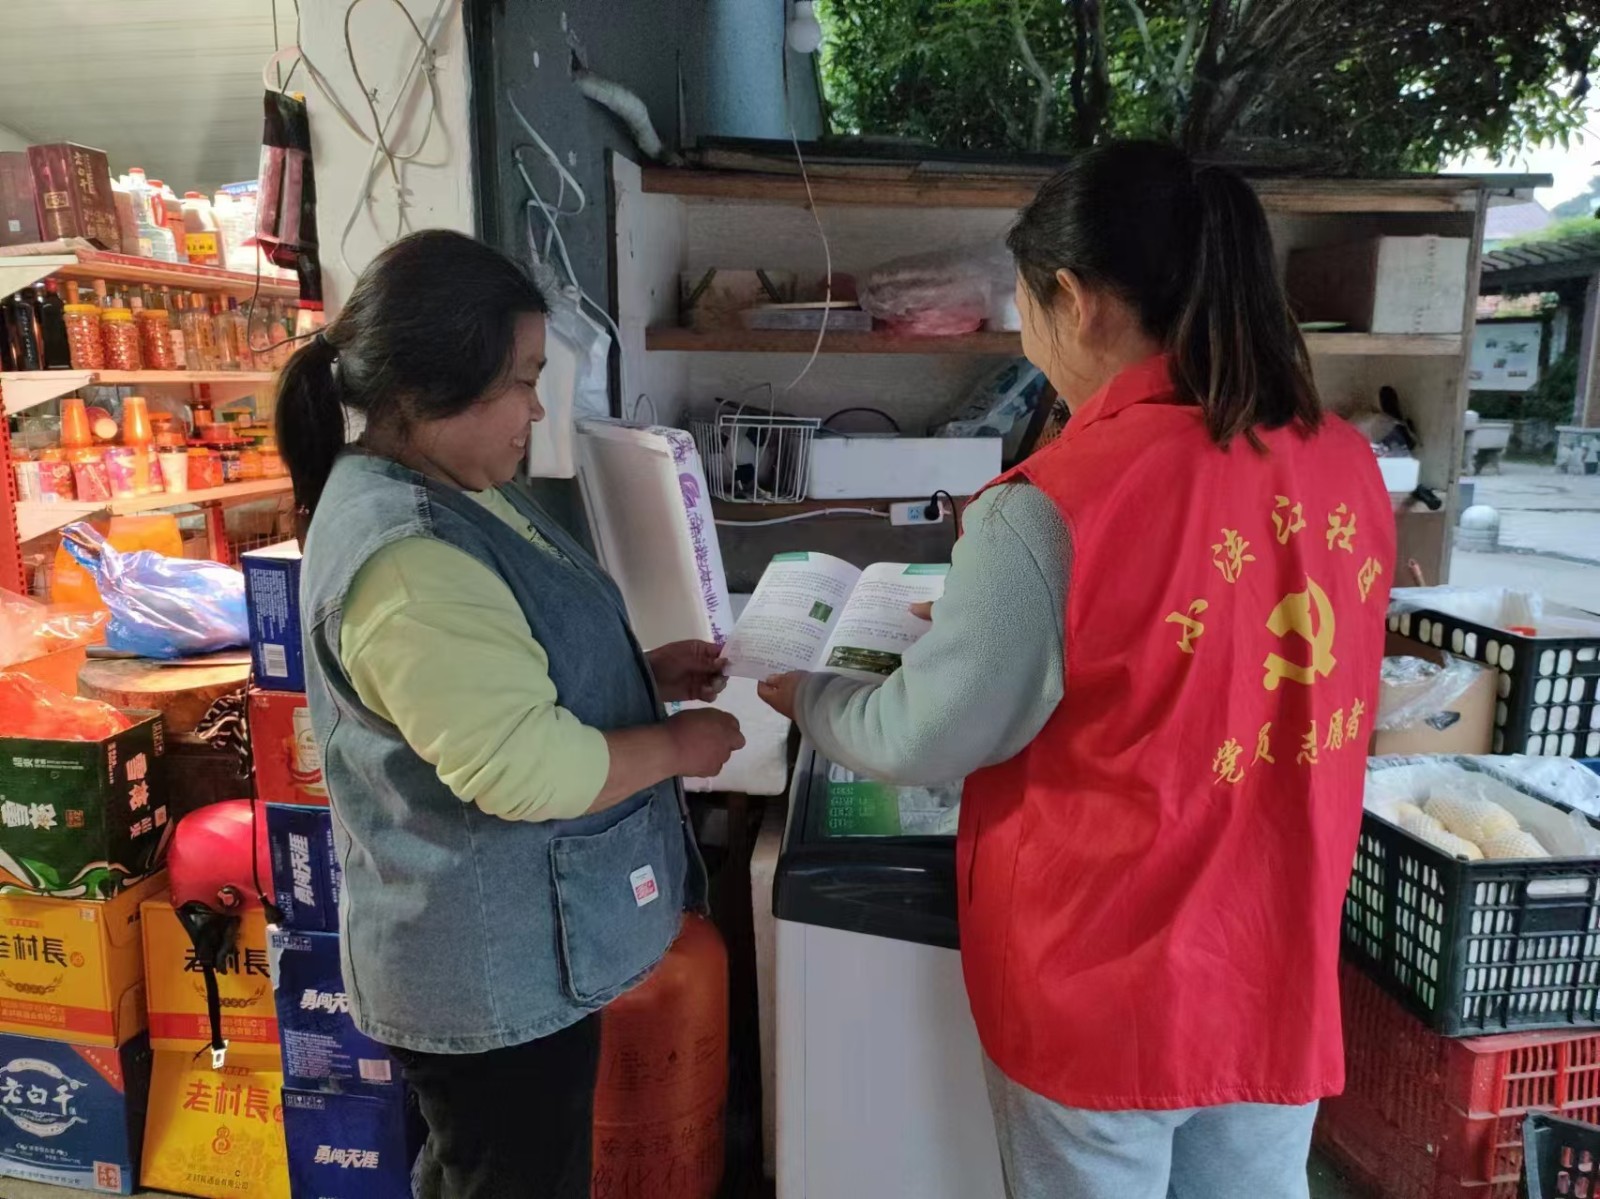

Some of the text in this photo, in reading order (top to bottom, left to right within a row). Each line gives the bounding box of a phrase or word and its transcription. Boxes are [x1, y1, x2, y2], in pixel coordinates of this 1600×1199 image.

[1213, 697, 1365, 785] 党员志愿者
[289, 832, 315, 907] 勇闯天涯
[0, 1077, 74, 1116] 老白干
[314, 1145, 379, 1169] 勇闯天涯
